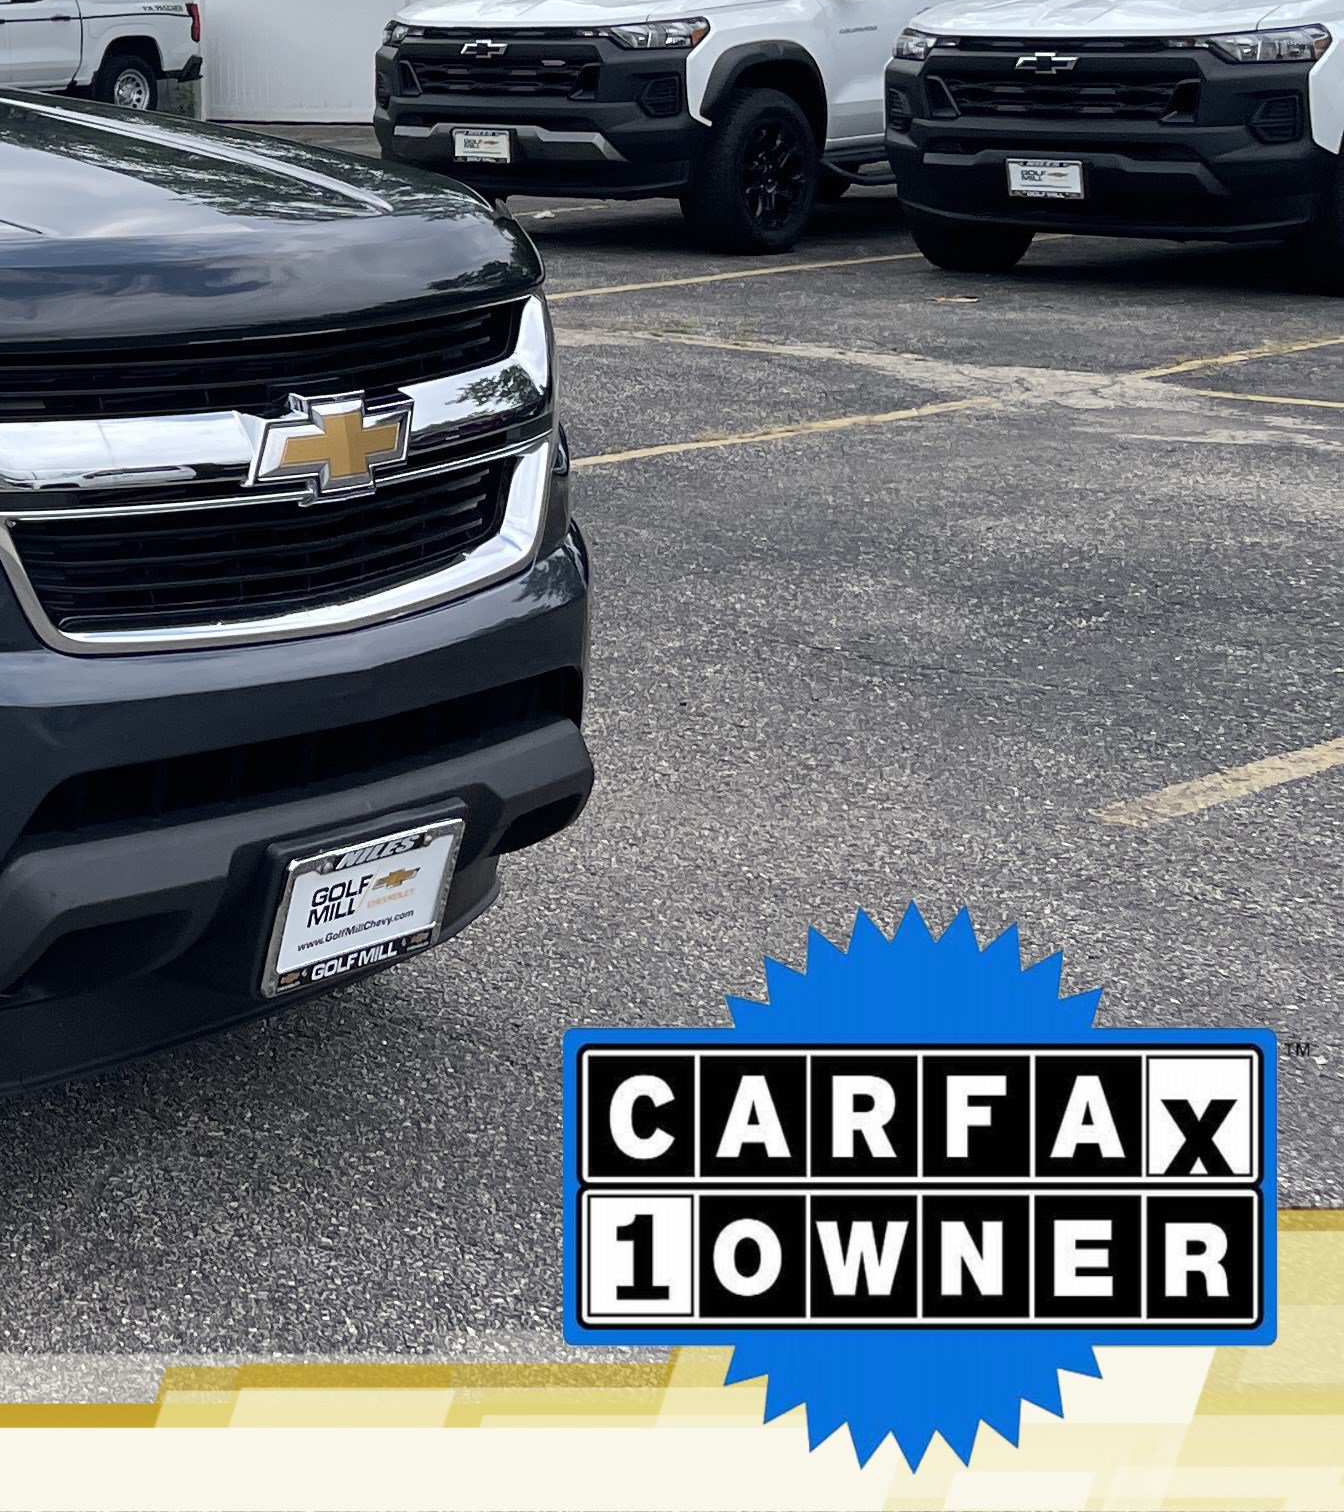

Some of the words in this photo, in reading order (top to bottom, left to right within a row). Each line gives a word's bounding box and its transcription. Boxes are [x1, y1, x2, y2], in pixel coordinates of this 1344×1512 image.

[311, 874, 374, 908] GOLF
[307, 898, 356, 928] MILL
[311, 952, 358, 981] GOLF
[358, 941, 398, 967] MILL
